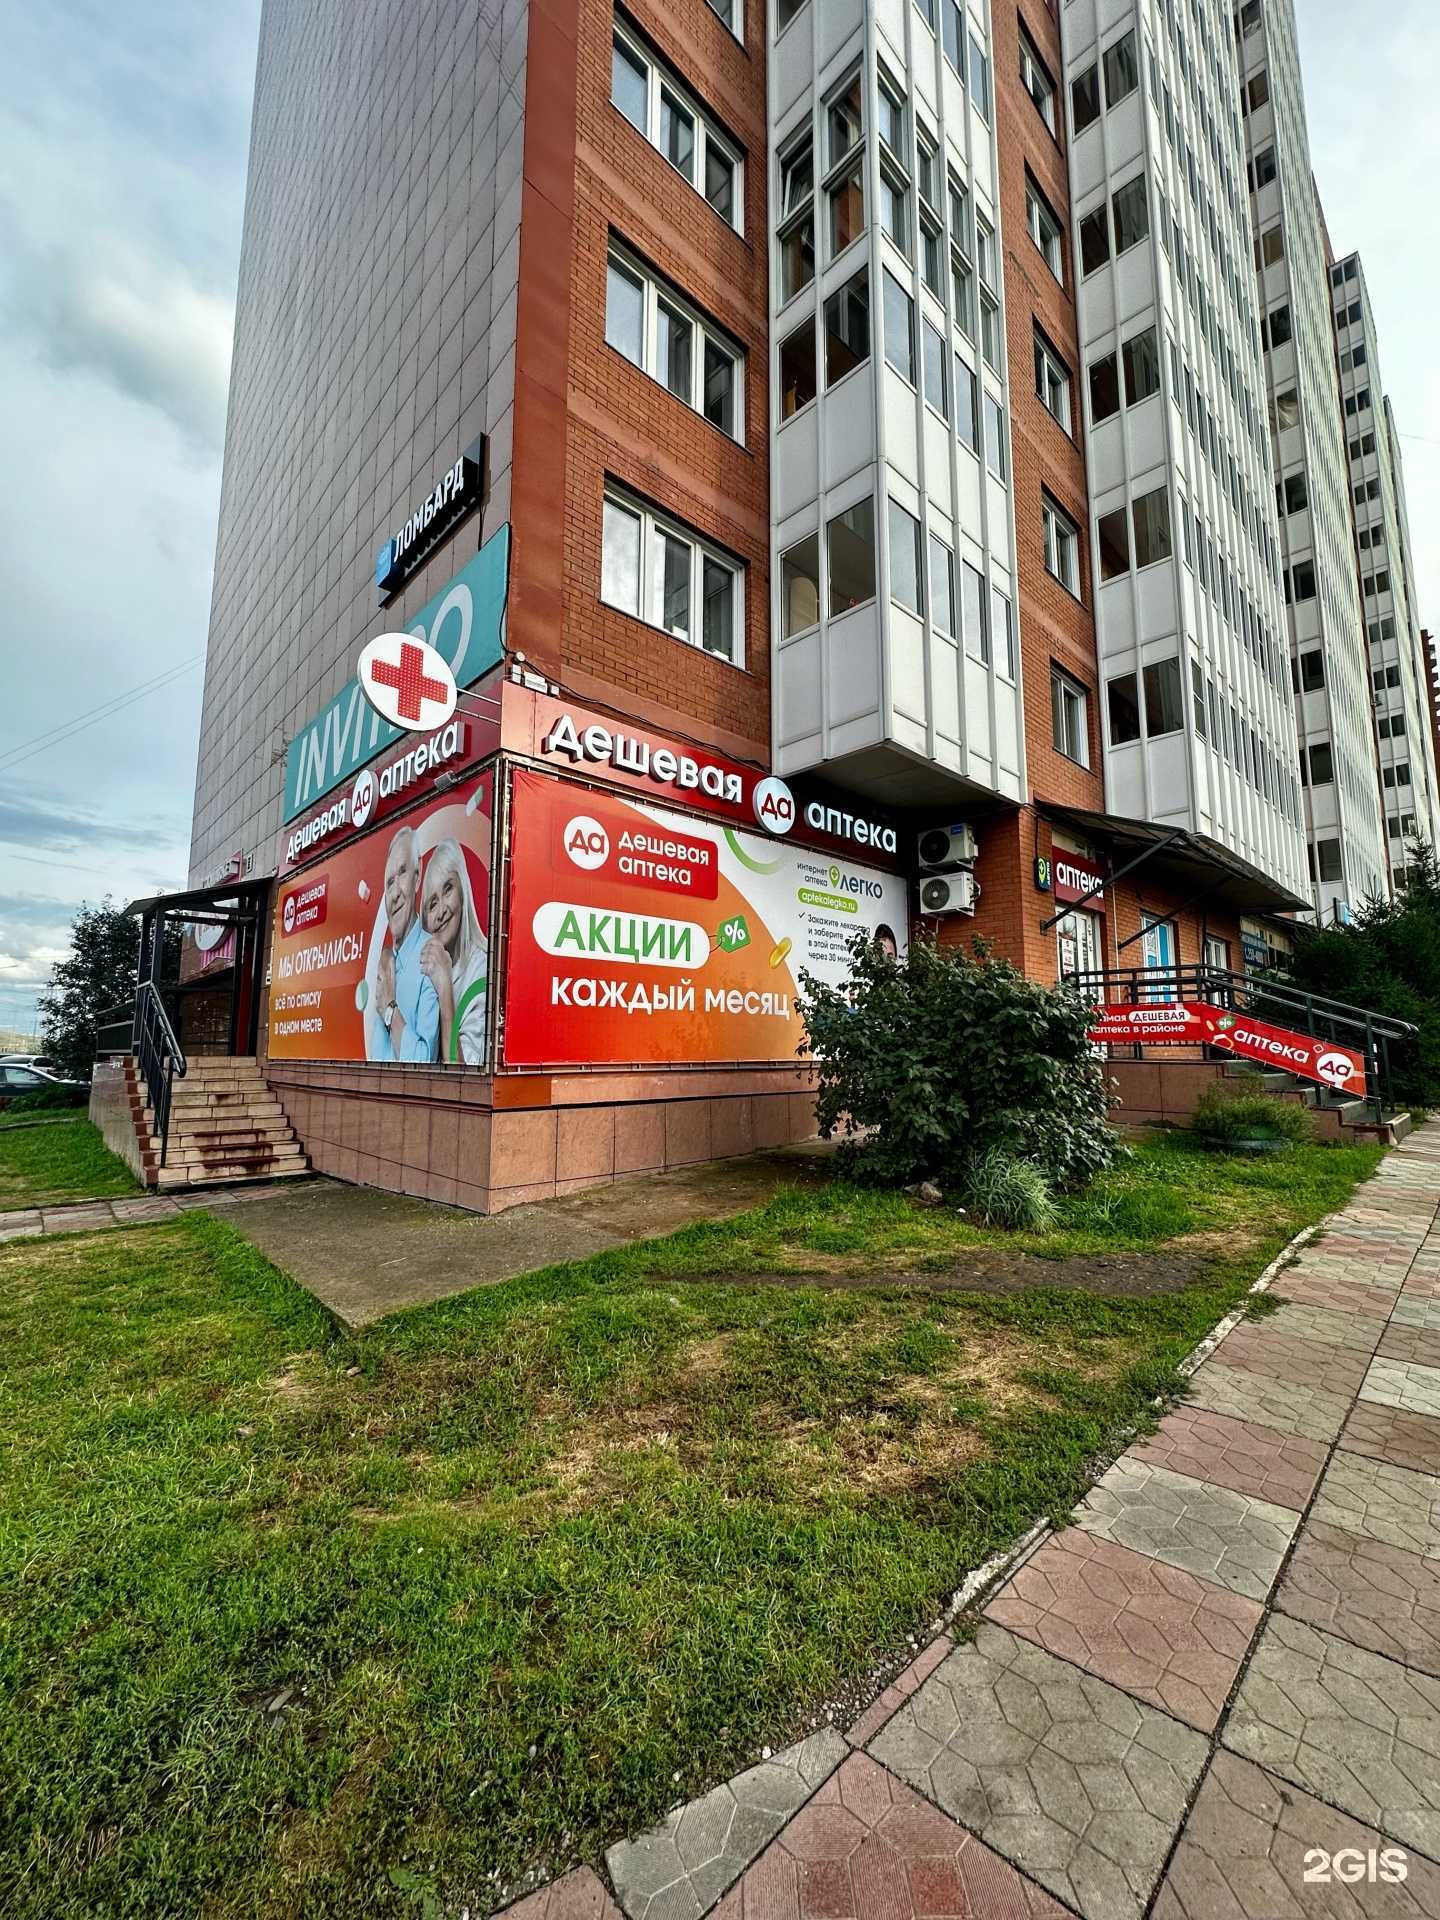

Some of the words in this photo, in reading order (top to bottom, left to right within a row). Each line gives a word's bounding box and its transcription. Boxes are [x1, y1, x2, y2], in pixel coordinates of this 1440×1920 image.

[394, 455, 465, 564] ЛОМБАРД
[294, 583, 474, 809] INVIO
[286, 797, 347, 864] дешевая
[379, 720, 459, 798] аптека
[547, 713, 743, 804] дешевая
[806, 802, 897, 854] аптека
[618, 831, 709, 866] дешевая
[618, 856, 692, 886] аптека
[804, 875, 828, 887] аптека
[1056, 861, 1104, 899] аптека
[296, 883, 326, 910] дешевая
[839, 874, 883, 899] легко
[296, 905, 319, 926] аптека
[808, 914, 839, 928] Закажите
[553, 909, 692, 963] АКЦИИ
[814, 928, 844, 940] заберите
[814, 940, 829, 949] этой
[278, 951, 294, 979] МЫ
[295, 931, 364, 975] ОТКРЫЛИСЬ!
[808, 951, 828, 961] через
[287, 995, 296, 1009] по
[296, 990, 322, 1009] списку
[551, 975, 696, 1016] каждый
[704, 987, 790, 1021] месяц
[279, 1020, 300, 1037] одном
[300, 1017, 323, 1033] месте
[1094, 1025, 1131, 1034] аптека
[1141, 1024, 1186, 1035] районе
[1133, 1011, 1186, 1022] ДЕШЕВАЯ
[1233, 1029, 1310, 1064] аптека
